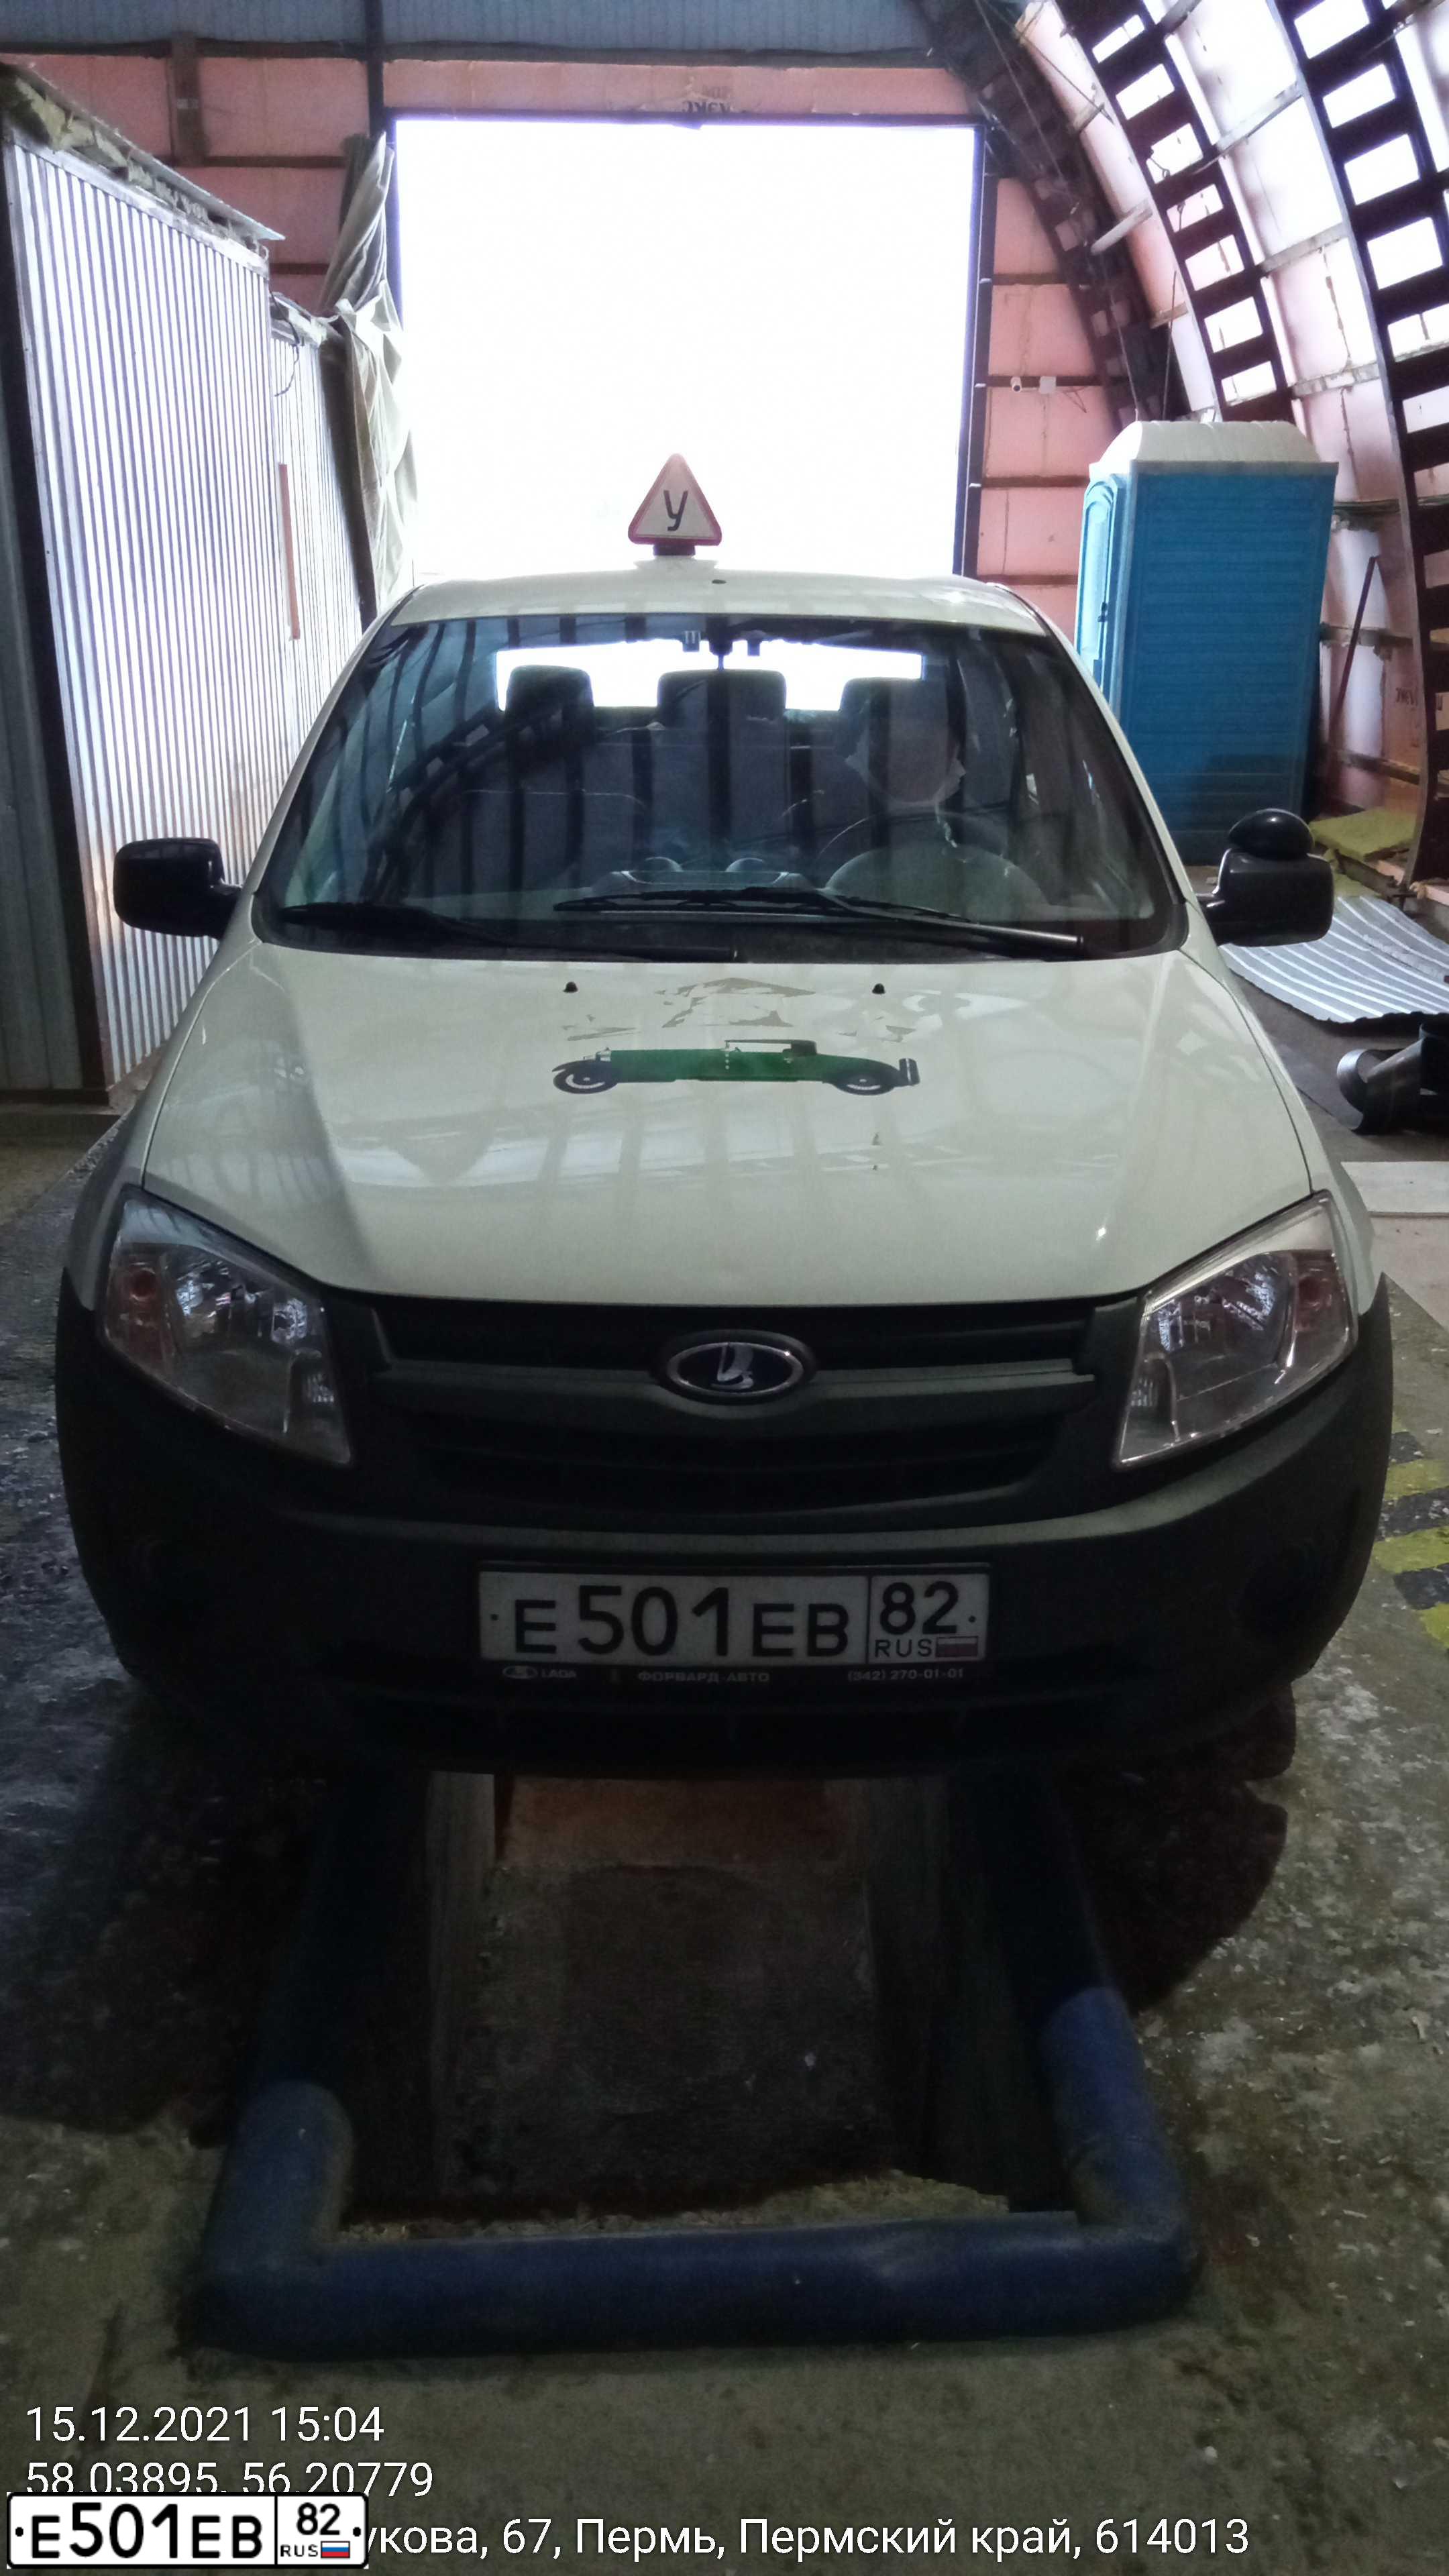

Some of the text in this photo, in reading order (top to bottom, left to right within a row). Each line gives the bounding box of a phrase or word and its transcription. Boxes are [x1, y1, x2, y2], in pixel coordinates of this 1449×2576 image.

[515, 1580, 959, 1656] Е501ЕВ 82
[874, 1638, 932, 1658] RUS
[847, 1668, 964, 1682] (342) 270-01-01
